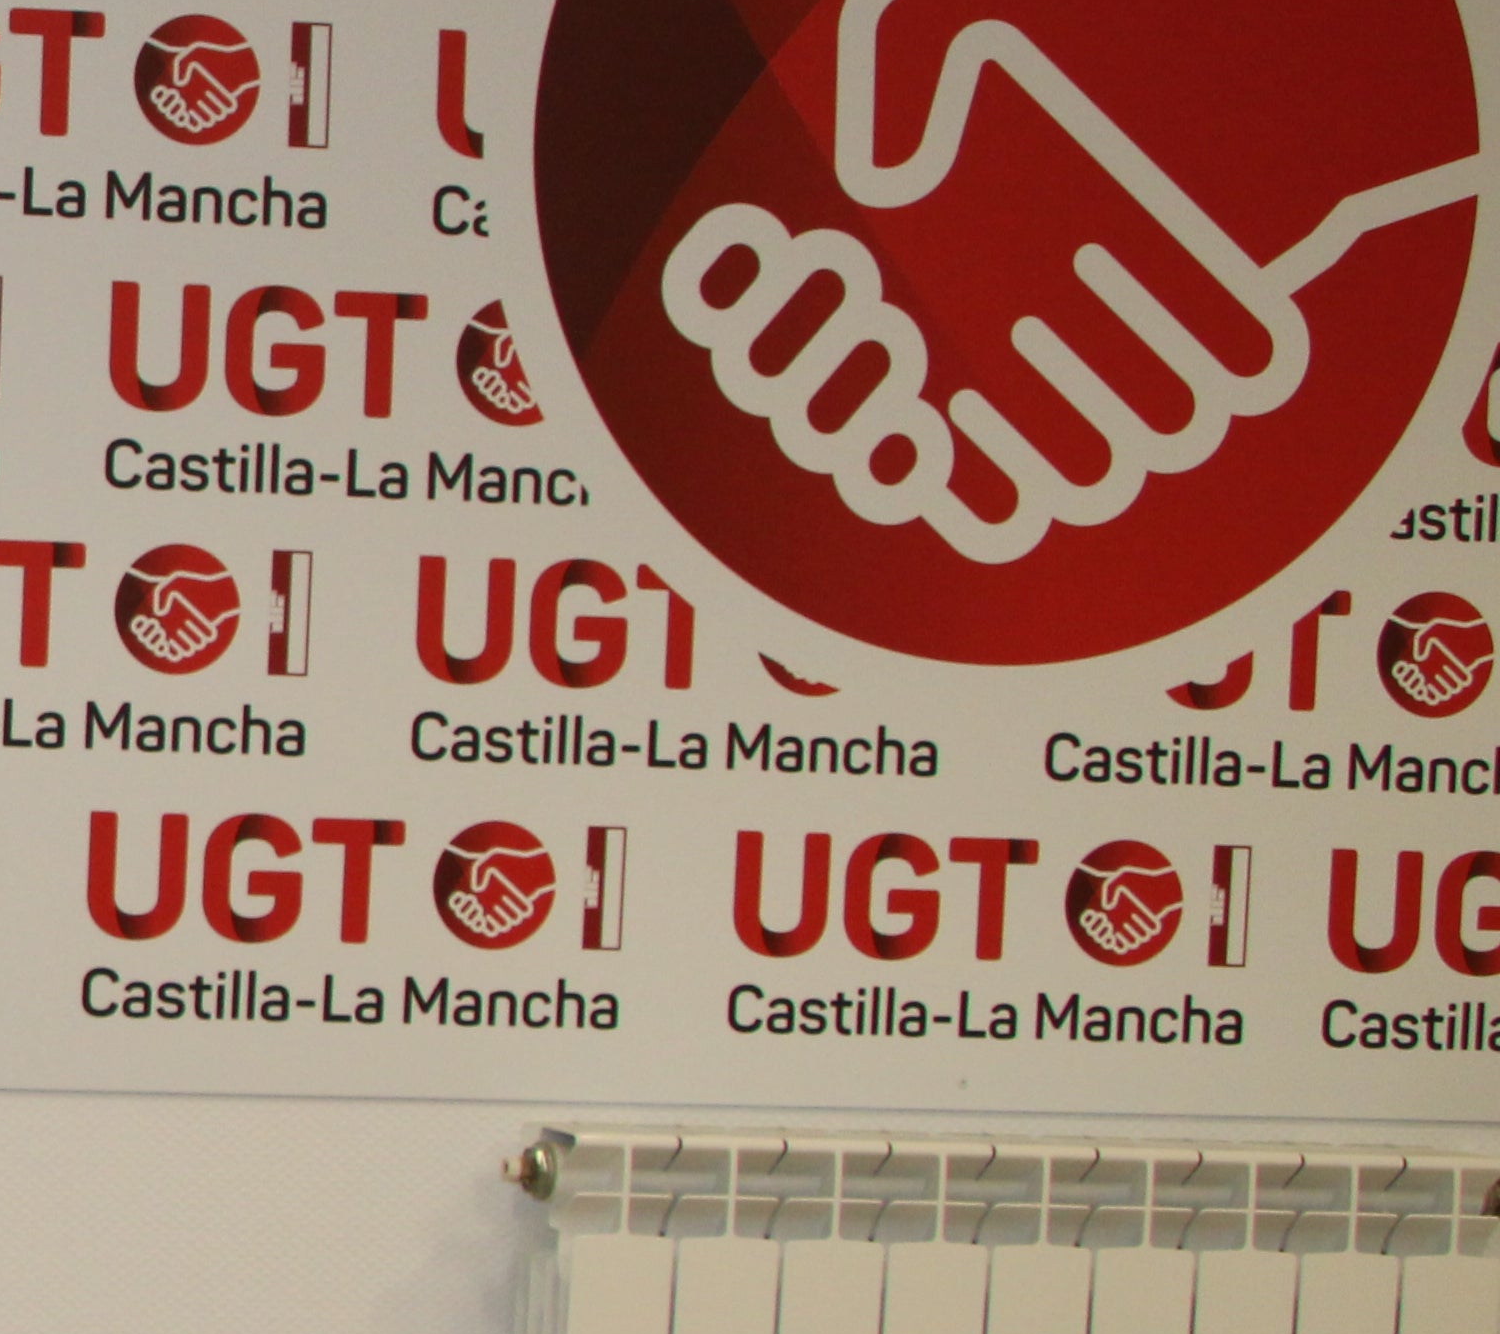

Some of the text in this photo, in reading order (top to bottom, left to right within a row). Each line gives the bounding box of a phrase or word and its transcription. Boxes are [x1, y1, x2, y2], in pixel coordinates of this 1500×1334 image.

[105, 171, 326, 229] Mancha
[109, 281, 428, 418] UGT
[105, 438, 589, 506] Castilla-La Manc
[85, 701, 305, 757] Mancha
[411, 711, 937, 777] Castilla-La Mancha
[1044, 732, 1500, 795] Castilla-La Manc
[87, 811, 405, 944] UGT
[733, 830, 1039, 961] UGT
[81, 967, 618, 1030] Castilla-La Mancha
[727, 984, 1242, 1045] Castilla-La Mancha
